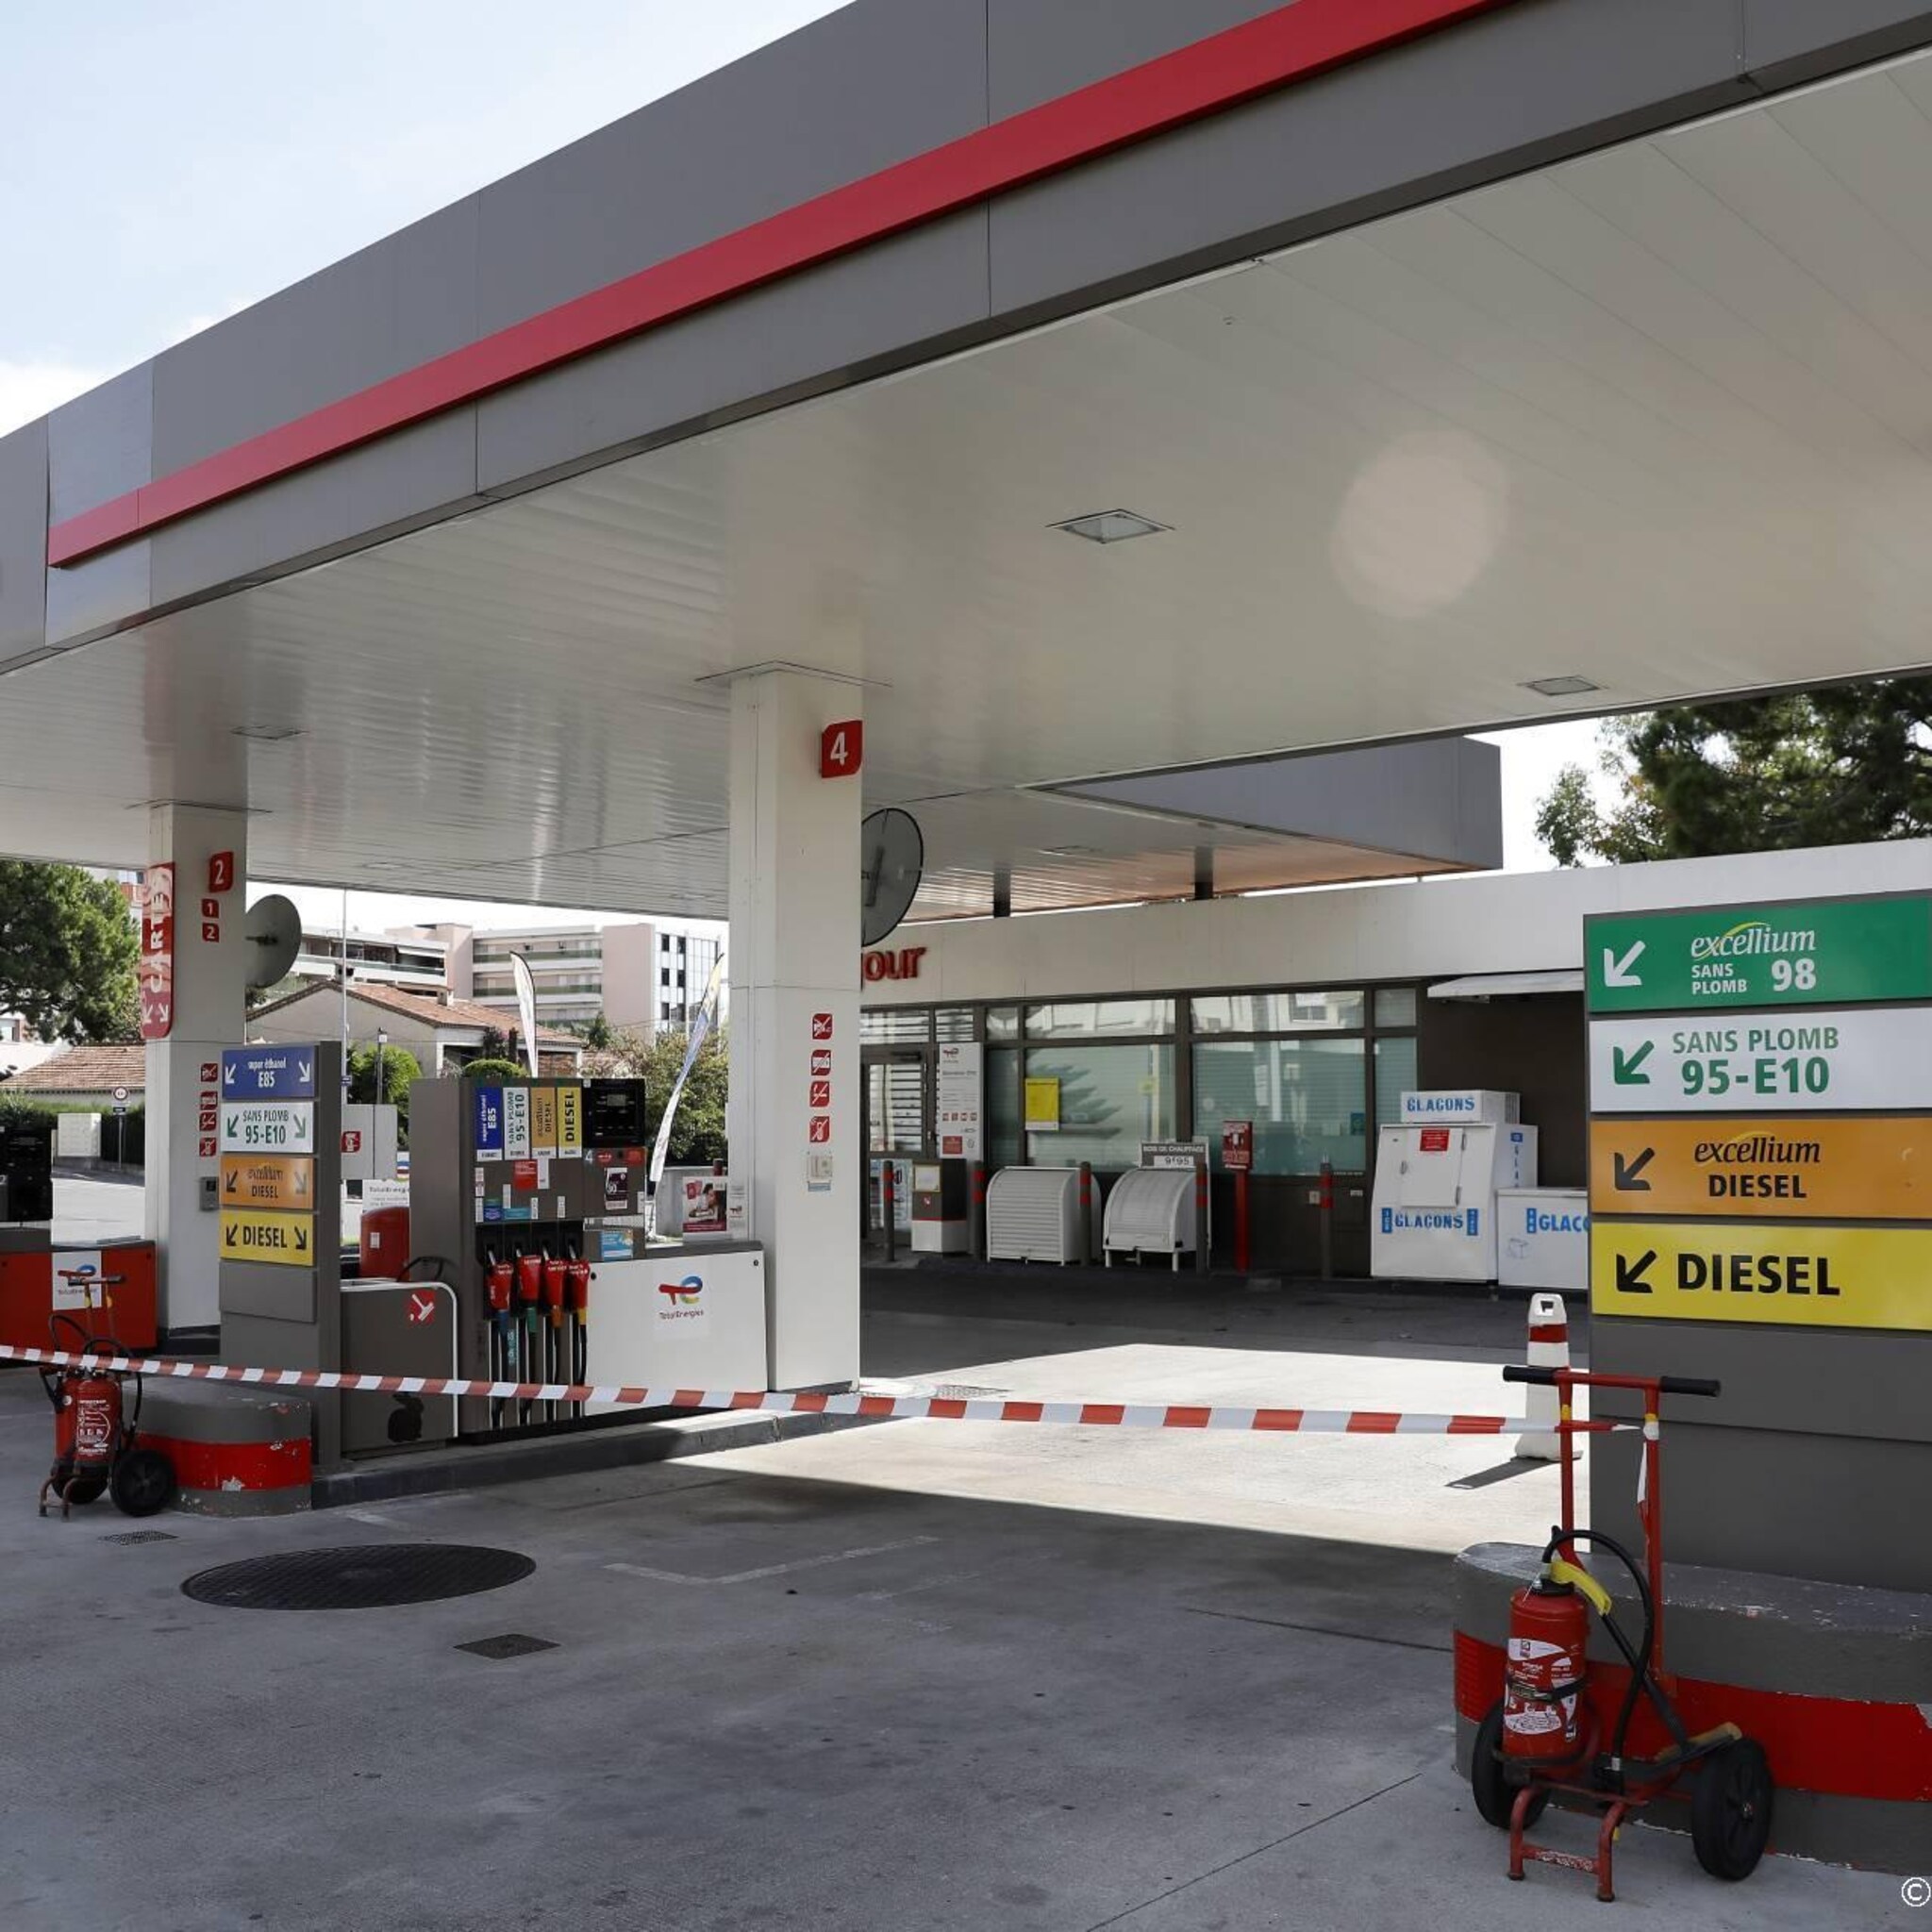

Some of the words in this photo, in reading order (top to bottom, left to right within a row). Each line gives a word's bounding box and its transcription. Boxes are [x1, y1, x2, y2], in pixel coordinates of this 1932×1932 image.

[830, 731, 848, 766] 4
[213, 859, 225, 885] 2
[207, 903, 212, 914] 1
[206, 926, 215, 940] 2
[1690, 925, 1817, 959] excellium
[862, 947, 927, 983] our
[1691, 962, 1734, 979] SANS
[1771, 958, 1818, 991] 98
[1691, 979, 1748, 995] PLOMB
[1673, 1029, 1739, 1055] SANS
[1748, 1026, 1839, 1052] PLOMB
[258, 1072, 275, 1088] E85
[1681, 1056, 1830, 1096] 95-E10
[242, 1109, 262, 1122] SANS
[264, 1109, 290, 1122] PLOMB
[487, 1108, 497, 1129] E85
[507, 1091, 515, 1121] PLOMB
[515, 1094, 525, 1141] 95-E10
[564, 1091, 575, 1142] DIESEL
[245, 1125, 287, 1144] 95-E10
[584, 1149, 595, 1165] 4
[1694, 1136, 1822, 1164] excellium
[251, 1185, 279, 1199] DIESEL
[1708, 1174, 1807, 1198] DIESEL
[242, 1224, 288, 1248] DIESEL
[1677, 1252, 1840, 1297] DIESEL
